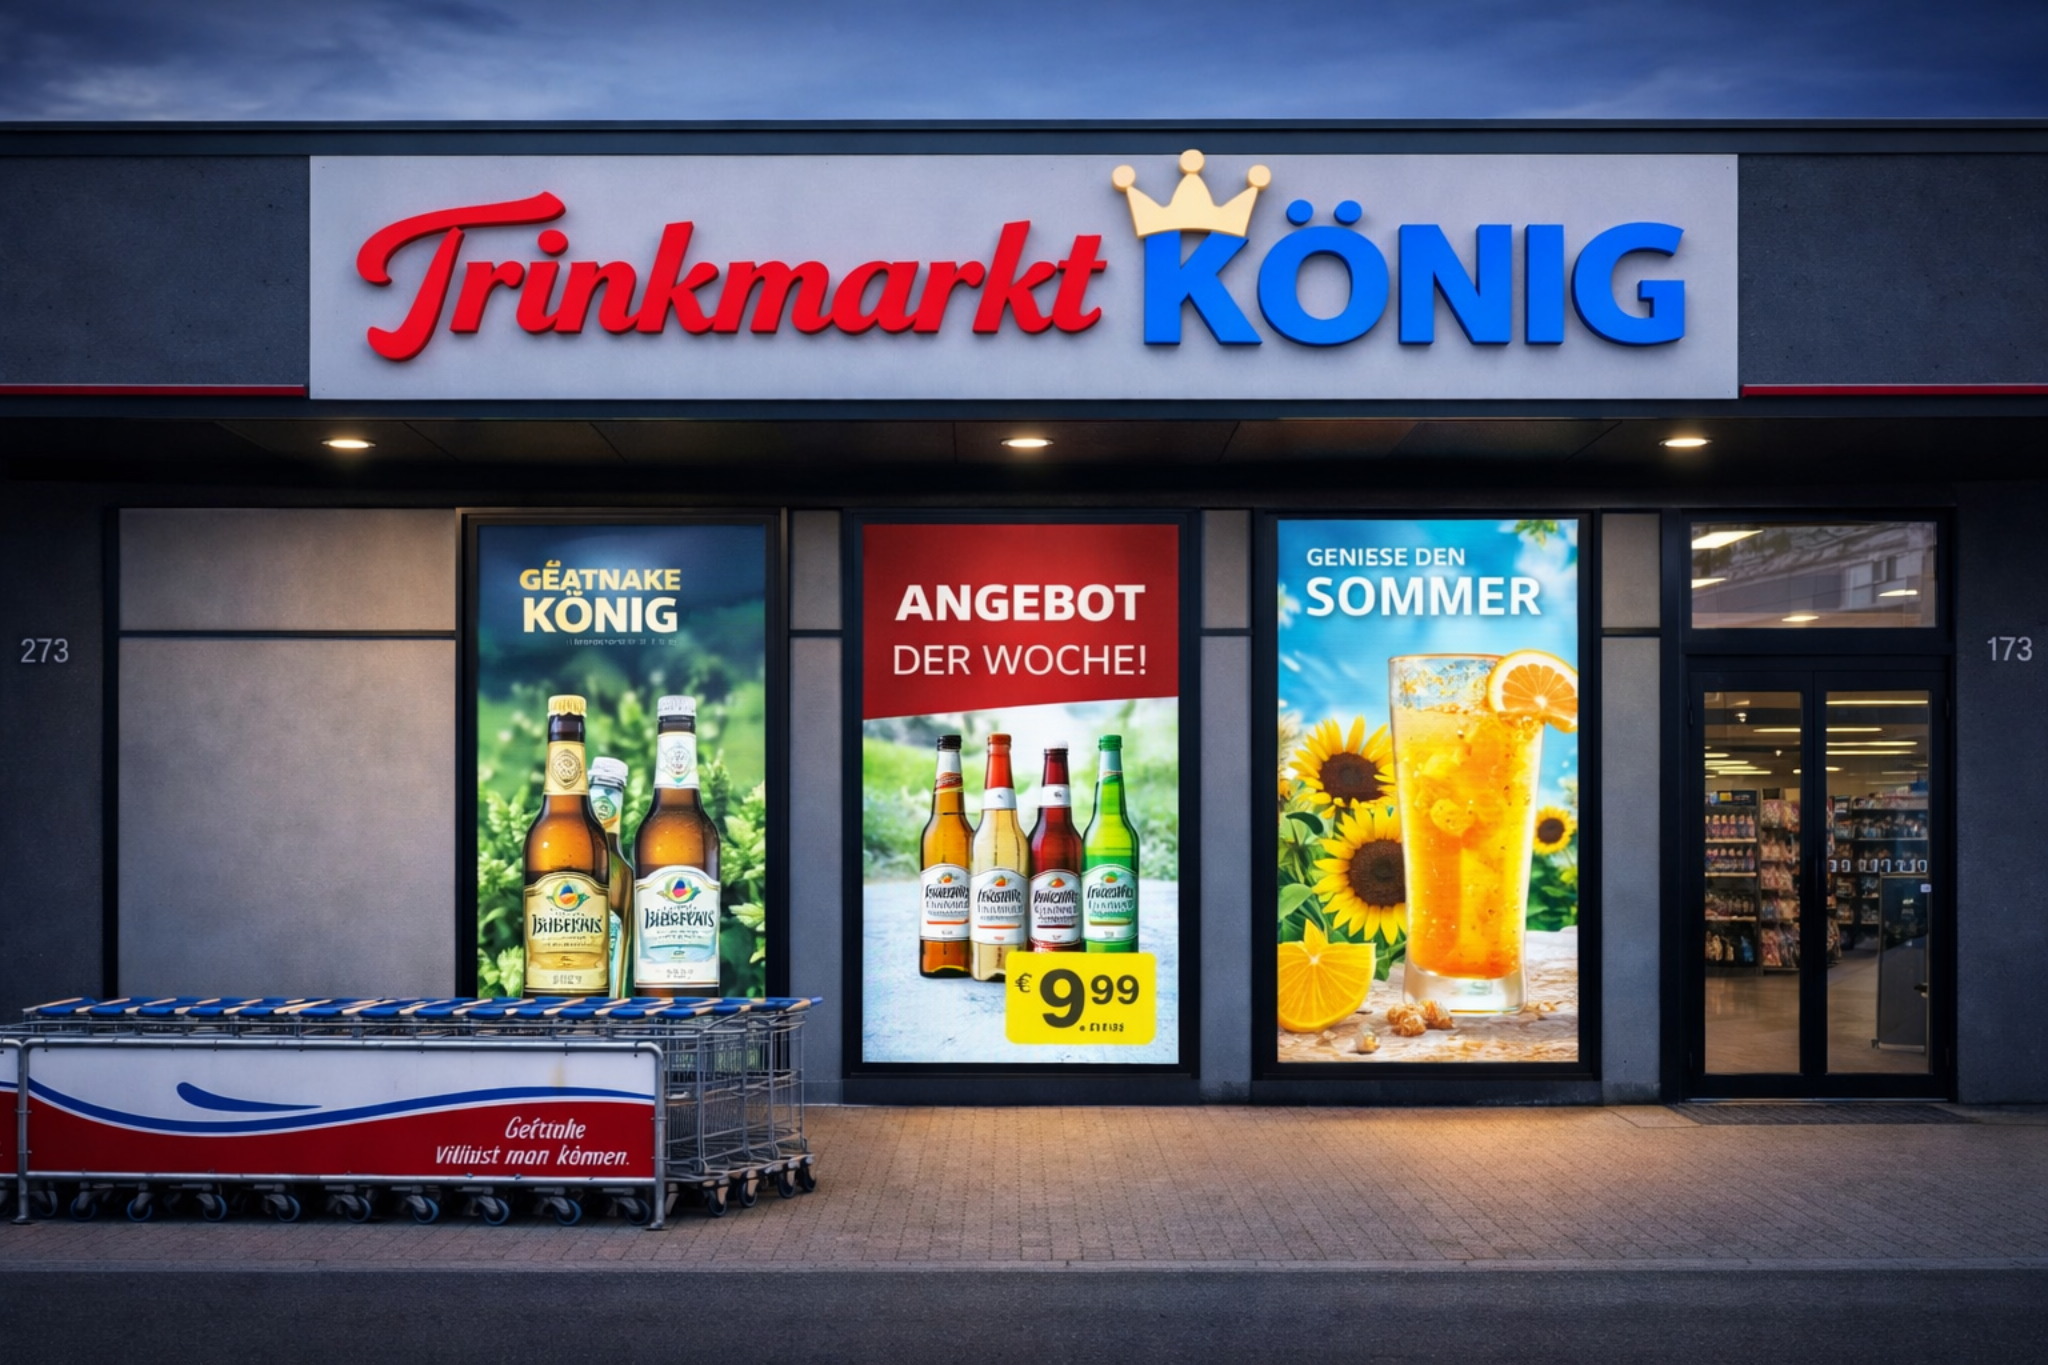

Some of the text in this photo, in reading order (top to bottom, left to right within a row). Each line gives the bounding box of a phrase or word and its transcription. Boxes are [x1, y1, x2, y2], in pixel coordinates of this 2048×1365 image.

[356, 191, 1686, 362] Trinkmarkt KÖNIG
[1415, 547, 1466, 567] DEN
[523, 589, 678, 633] KÖNIG
[895, 583, 1147, 622] ANGEBOT
[1305, 576, 1542, 617] SOMMER
[20, 638, 70, 663] 273
[893, 644, 1147, 676] DER WOCHE!
[1987, 636, 2033, 662] 173
[503, 1149, 550, 1166] man
